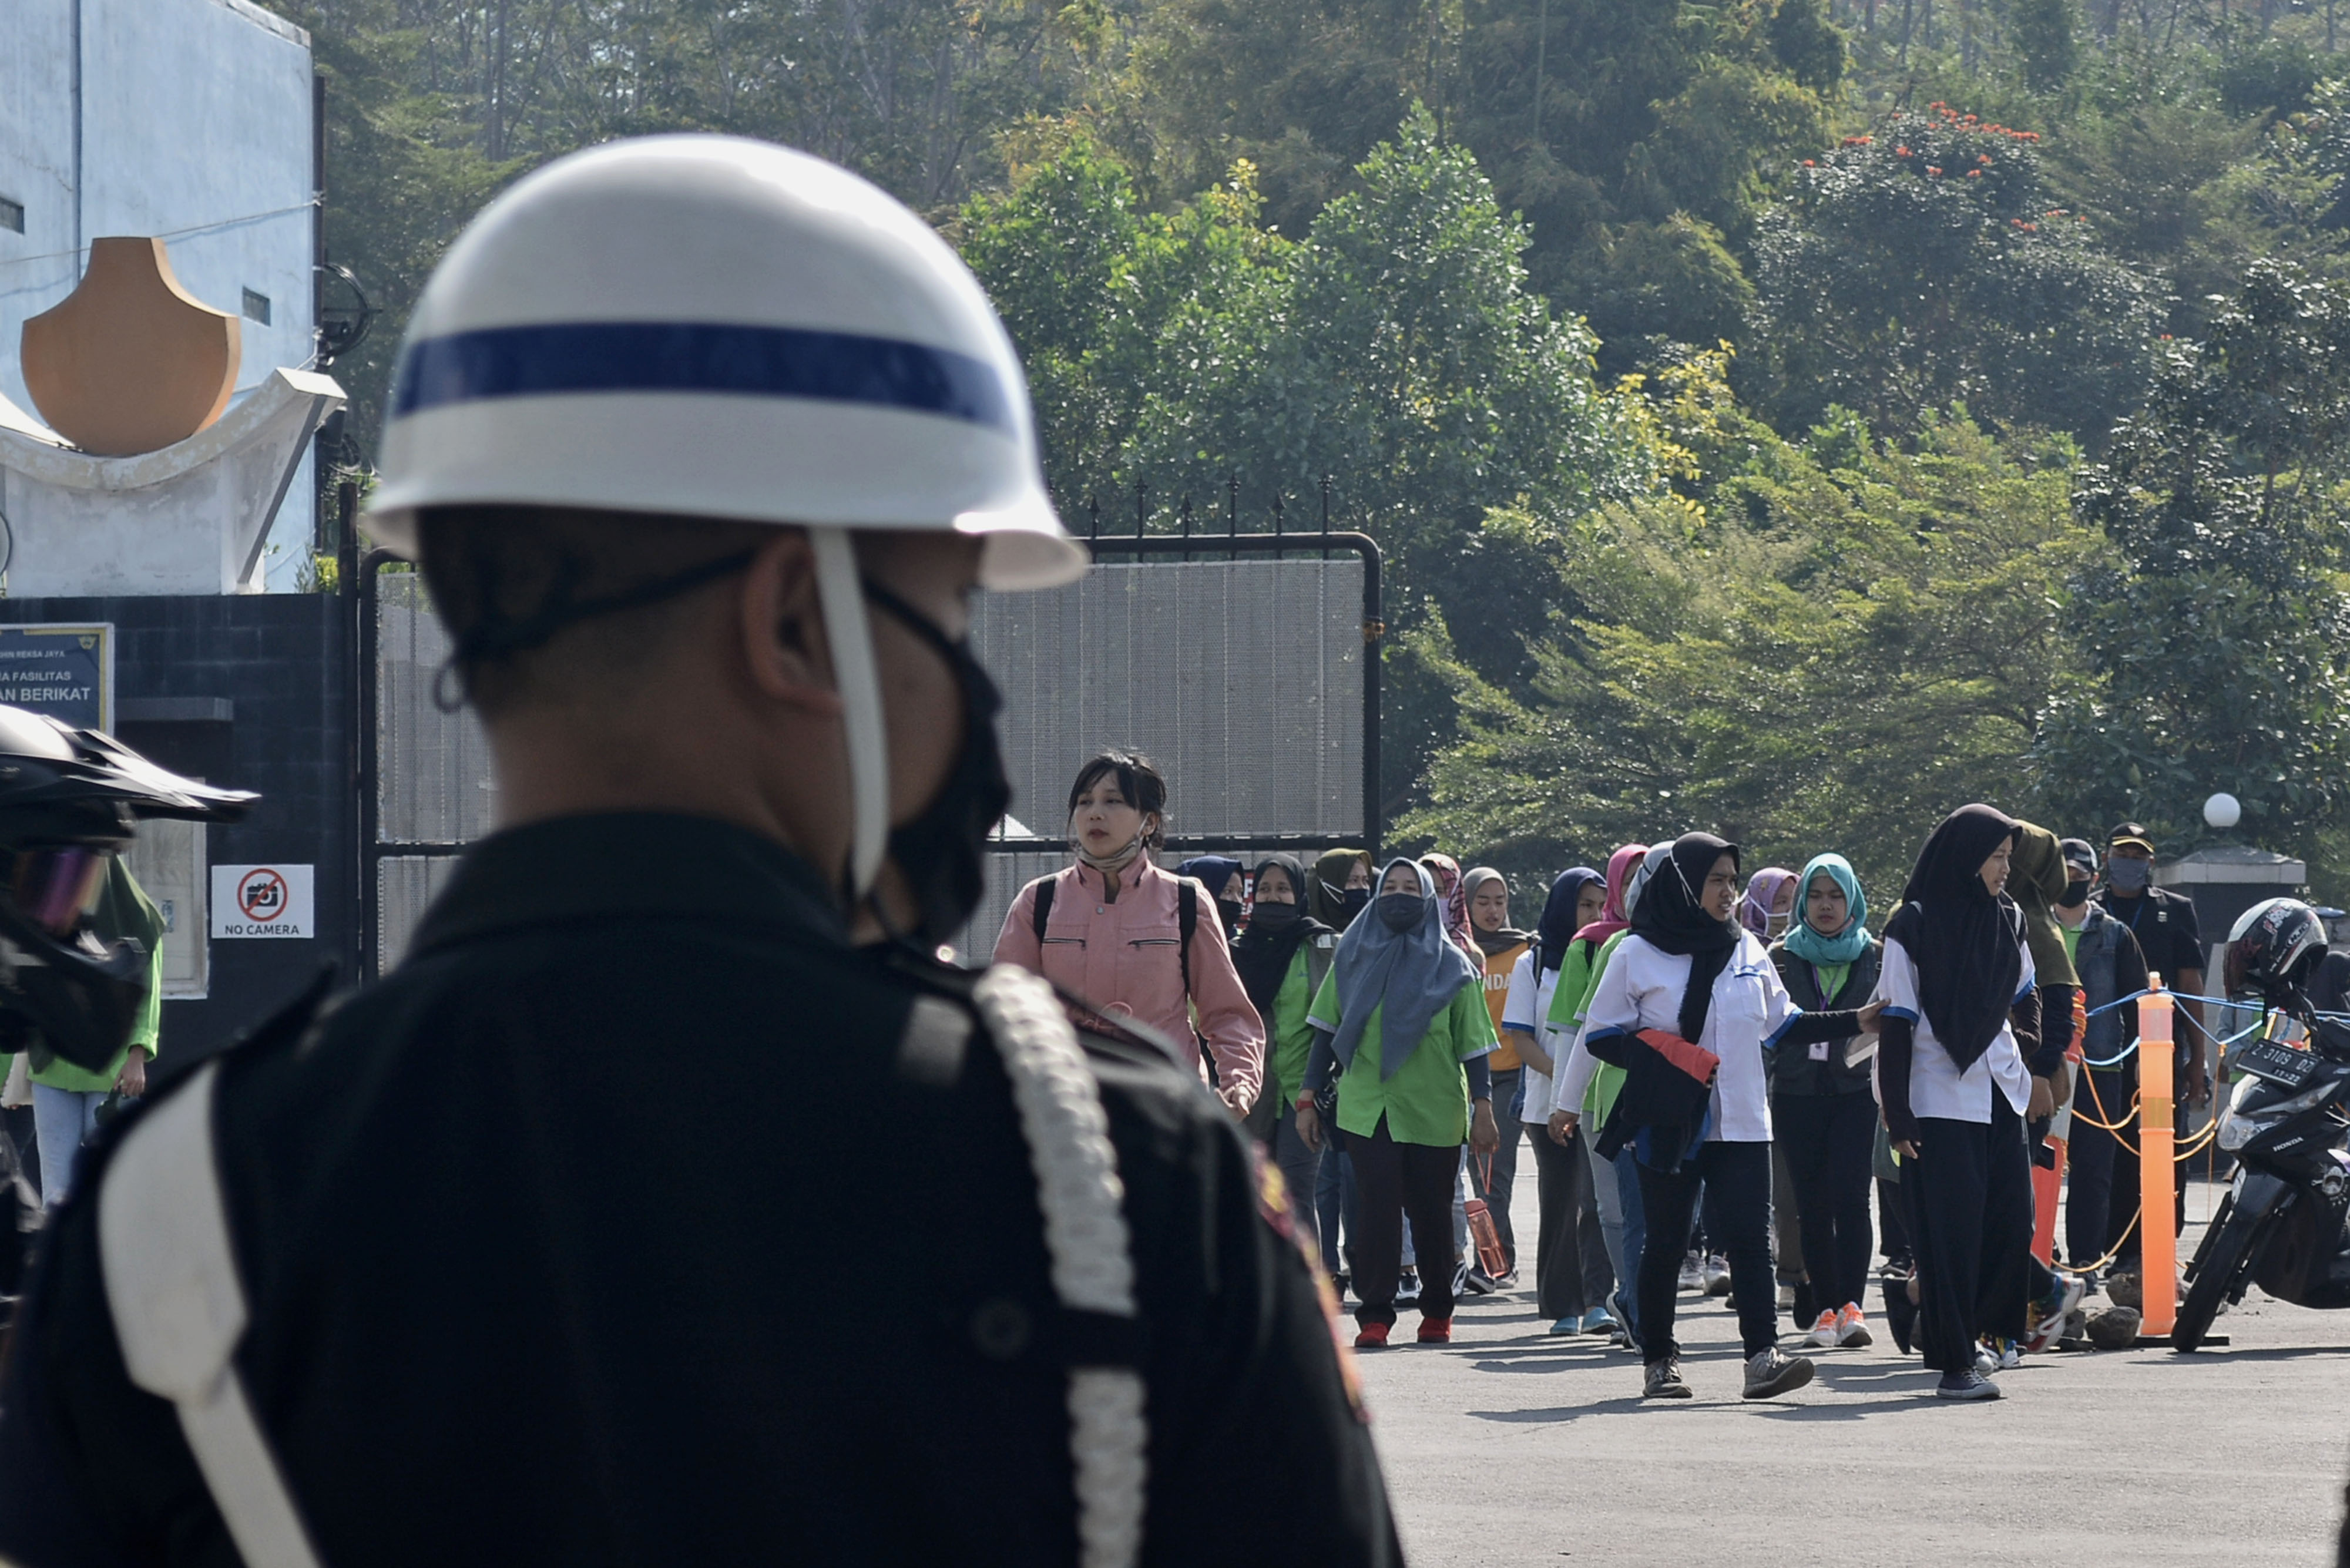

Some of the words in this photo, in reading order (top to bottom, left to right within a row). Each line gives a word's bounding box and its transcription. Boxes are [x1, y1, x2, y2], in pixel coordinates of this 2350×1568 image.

[12, 671, 71, 681] FASILITAS
[21, 687, 90, 701] BERIKAT
[225, 925, 243, 935] NO
[247, 925, 299, 935] CAMERA
[2251, 1044, 2264, 1056] Z
[2272, 1136, 2304, 1152] HONDA
